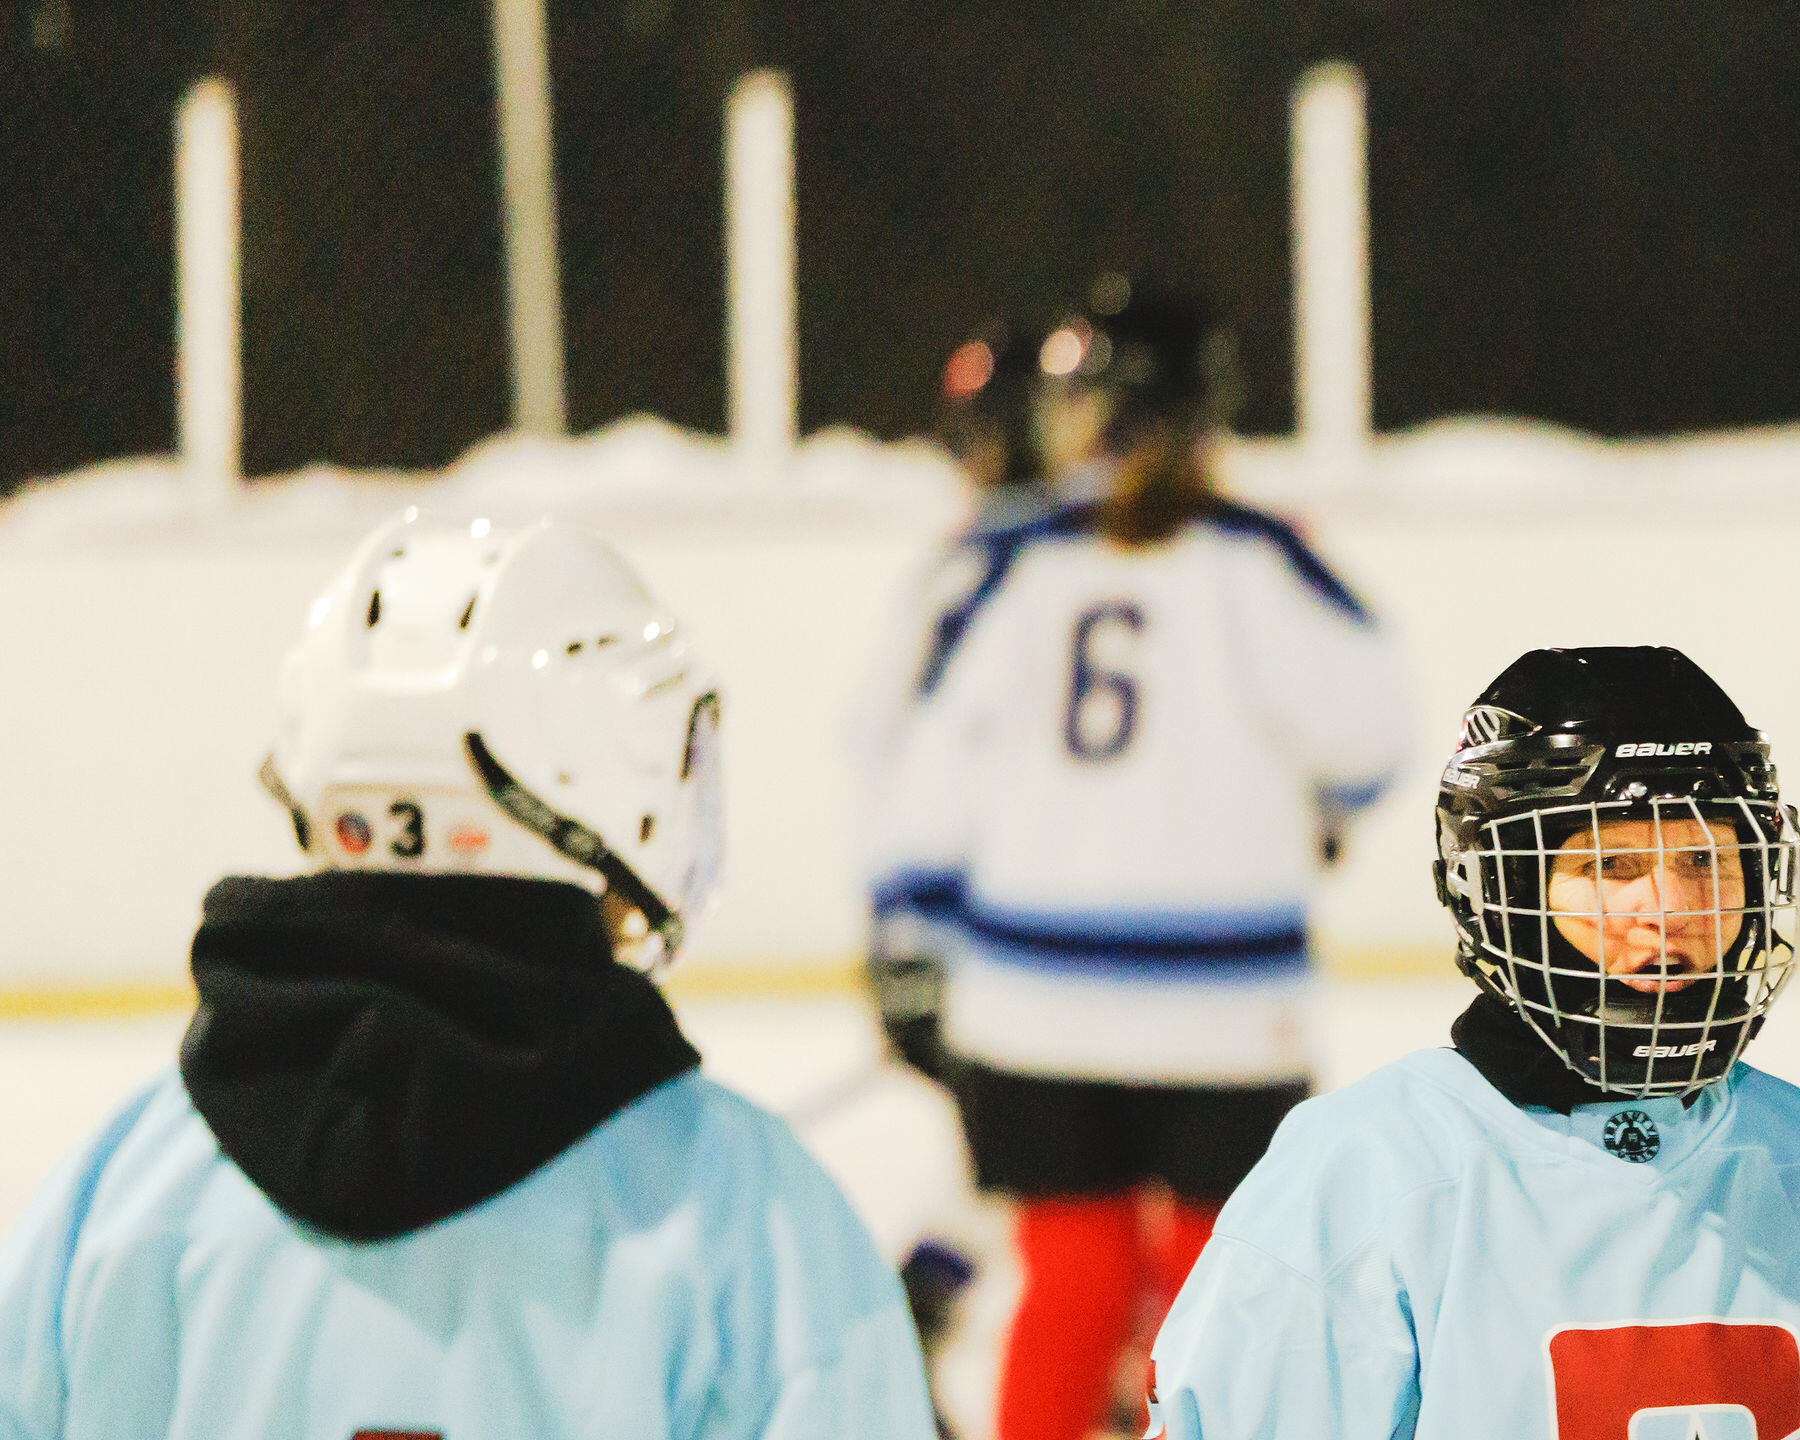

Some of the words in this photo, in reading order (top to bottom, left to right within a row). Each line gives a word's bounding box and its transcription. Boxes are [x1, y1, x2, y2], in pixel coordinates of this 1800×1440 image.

[1061, 600, 1147, 766] 6
[1615, 742, 1713, 758] BAUER
[388, 801, 425, 858] 3
[1632, 1039, 1717, 1058] BAUER
